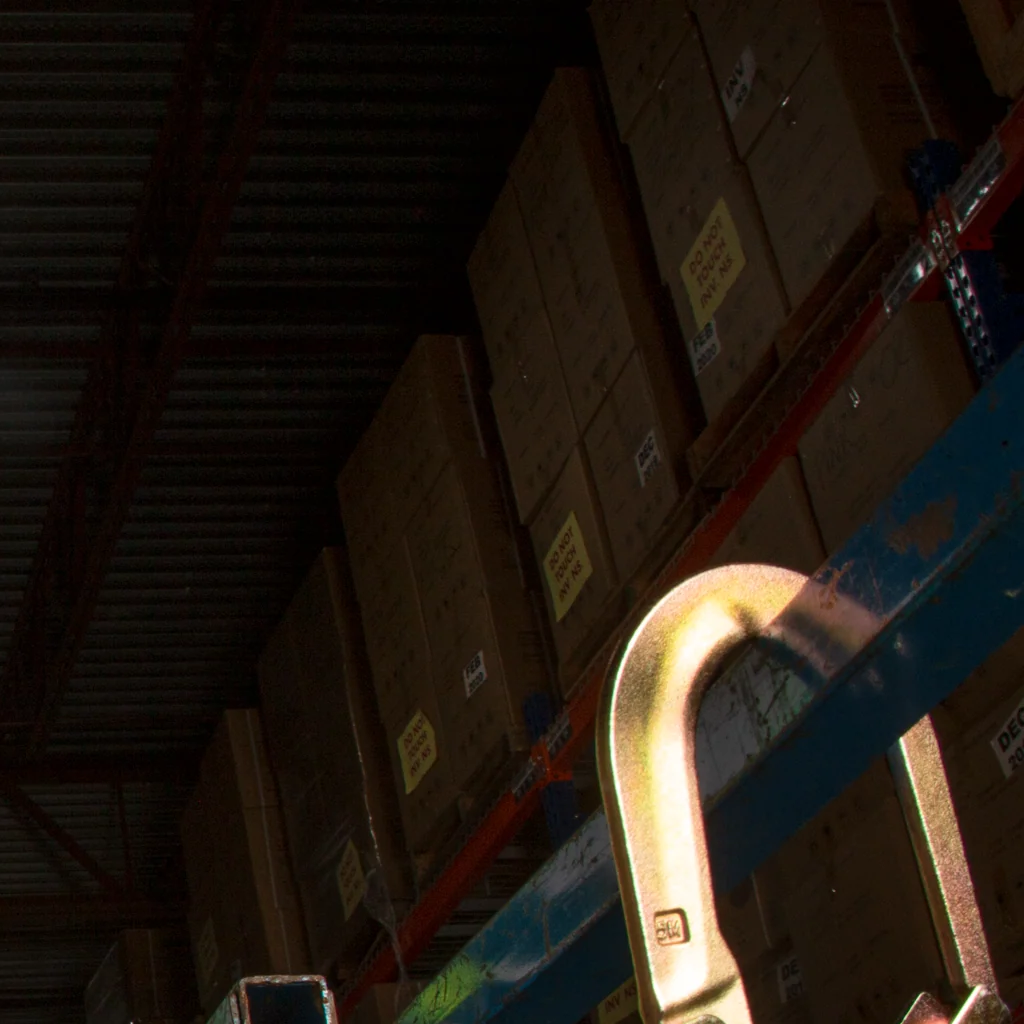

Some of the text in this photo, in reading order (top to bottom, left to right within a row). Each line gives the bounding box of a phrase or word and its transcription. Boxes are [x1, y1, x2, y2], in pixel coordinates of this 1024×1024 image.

[689, 215, 723, 275] DO NOT
[696, 236, 727, 287] TOUCH
